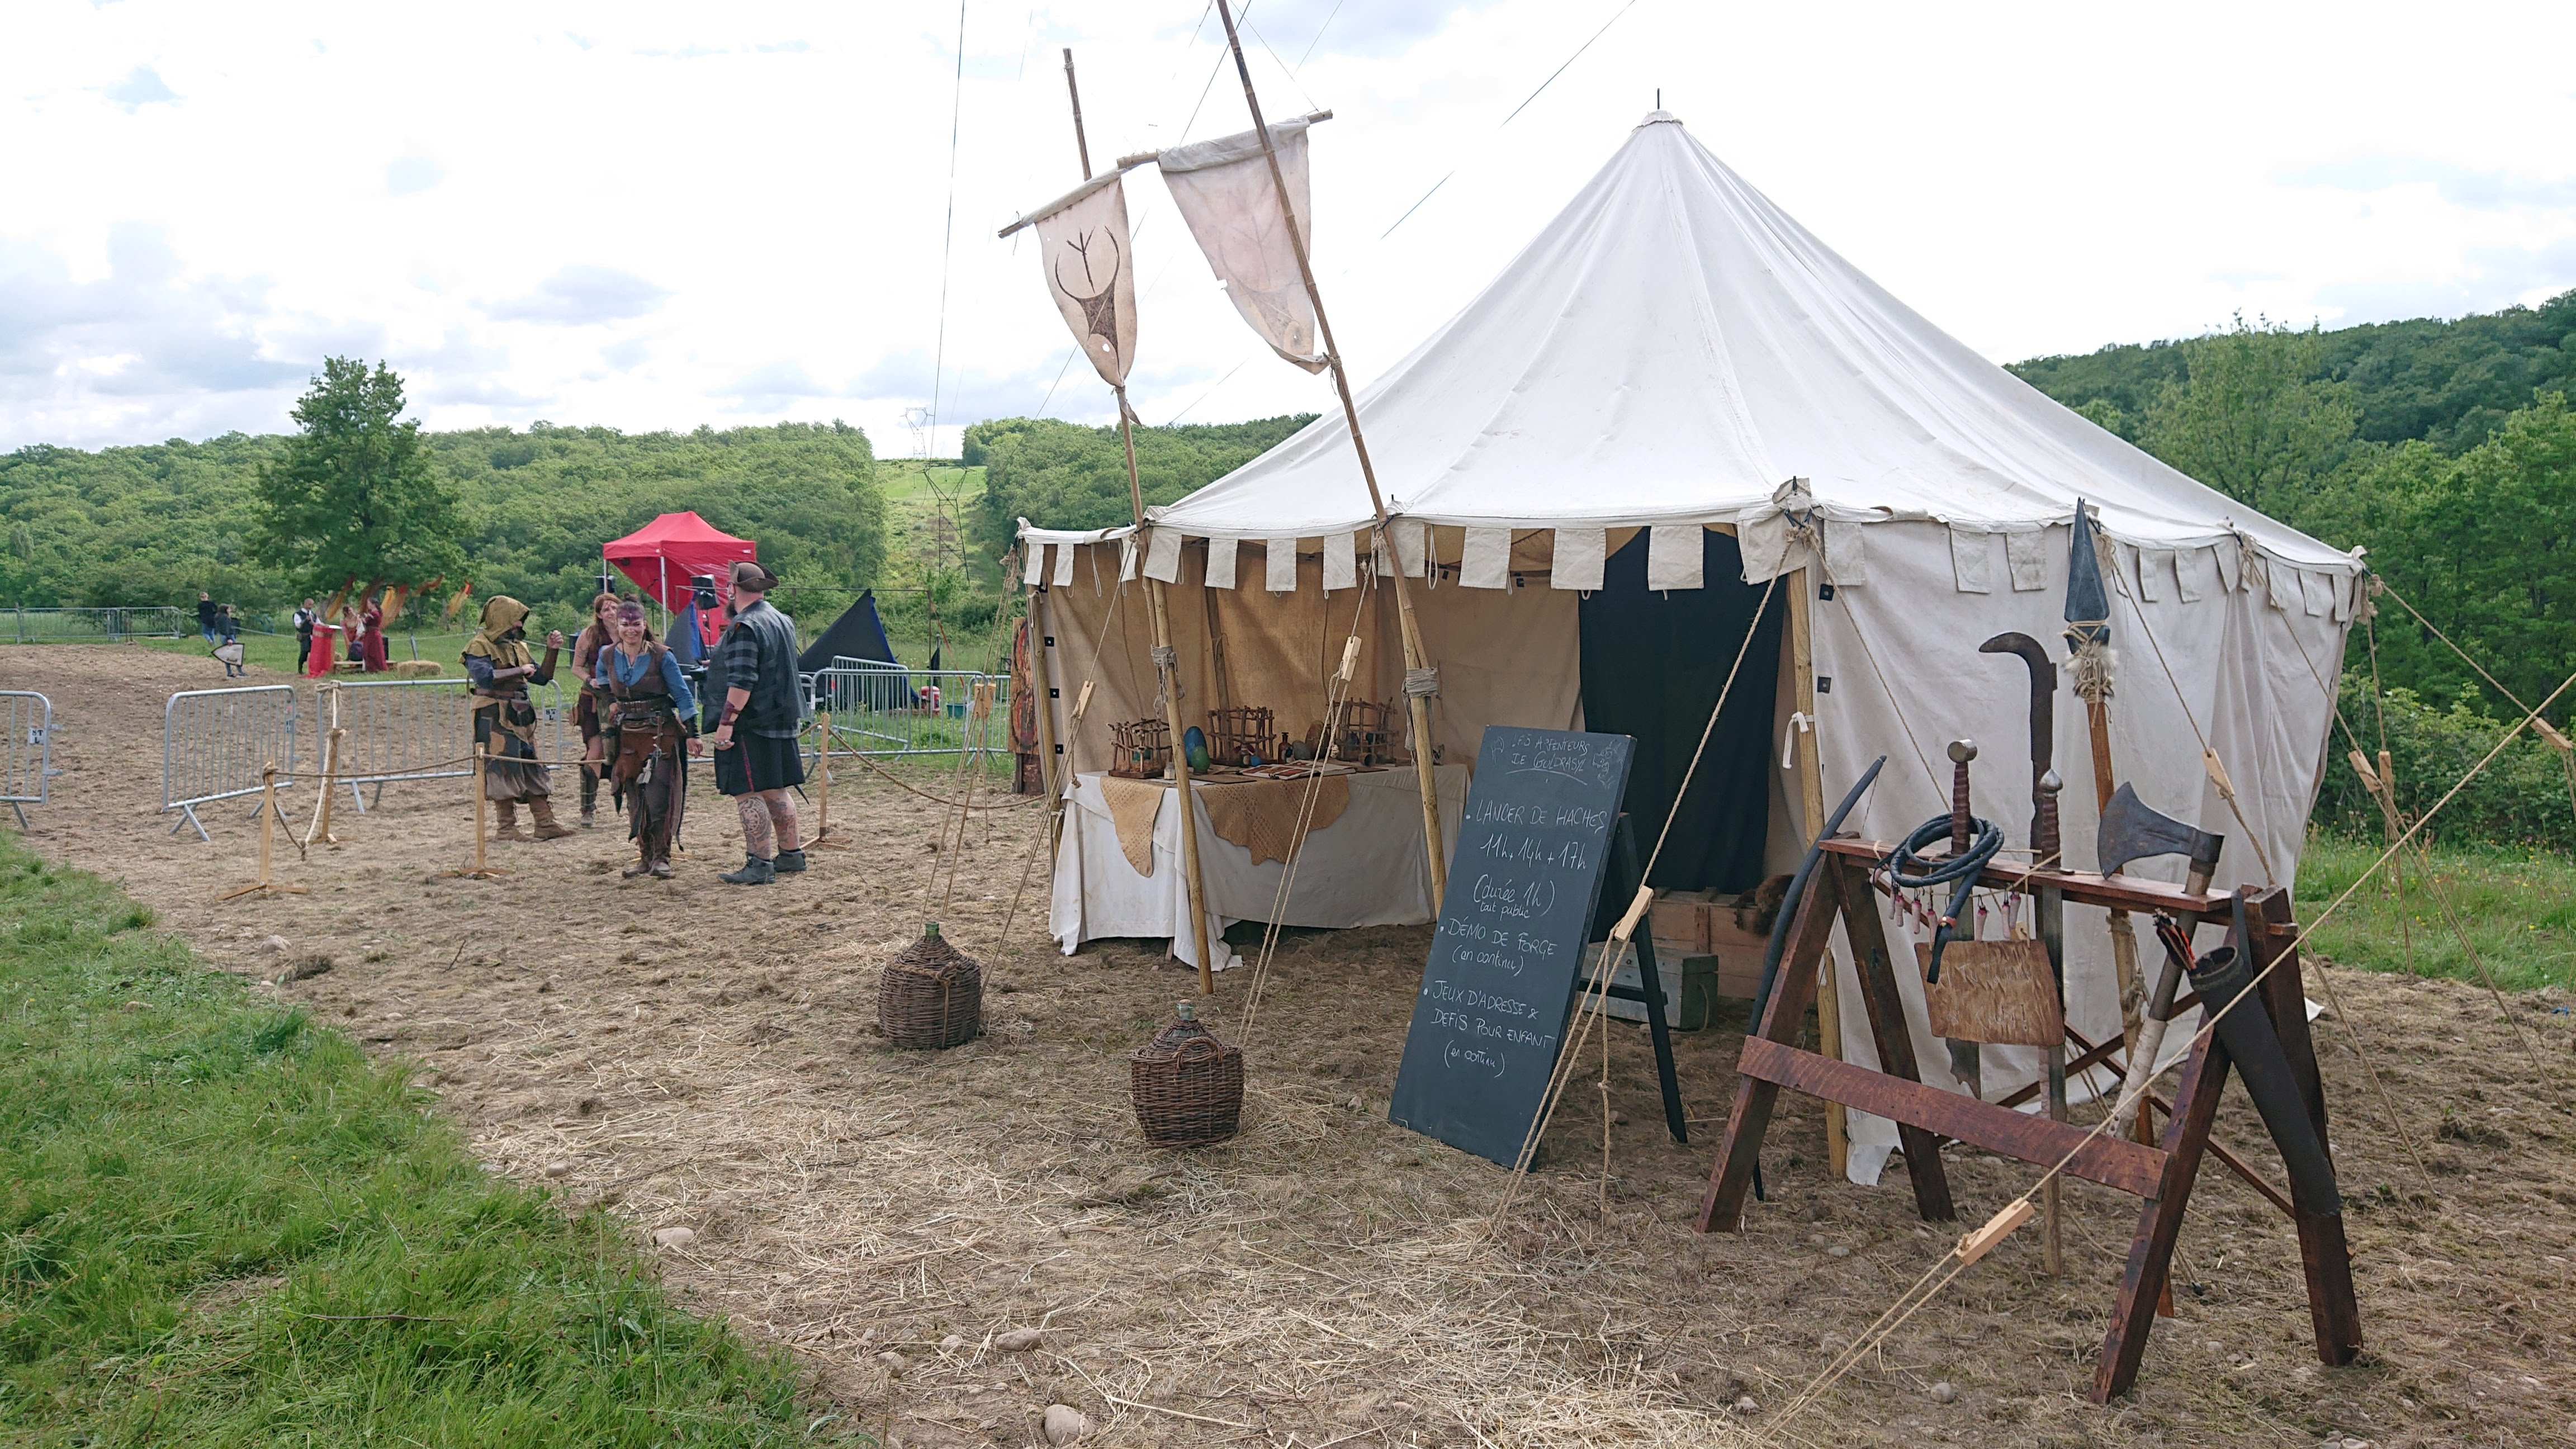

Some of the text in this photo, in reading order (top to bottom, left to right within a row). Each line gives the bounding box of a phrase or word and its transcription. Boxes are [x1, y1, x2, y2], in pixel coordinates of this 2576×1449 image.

[1476, 799, 1607, 835] LANCER DE HACHES
[1480, 832, 1508, 858] 11h
[1518, 836, 1542, 868] 14h
[1547, 851, 1555, 865] +
[1557, 840, 1586, 870] 17h
[1472, 874, 1516, 903] (durée
[1480, 901, 1531, 922] tout public
[1447, 916, 1558, 961] DÉMO DE FORGE
[1451, 944, 1525, 977] (en continu)
[1432, 979, 1539, 1020] JEUX D'ADRESSE &
[1475, 1017, 1502, 1039] POUR
[1507, 1029, 1557, 1049] ENFANT
[1444, 1039, 1505, 1078] (en continu)
